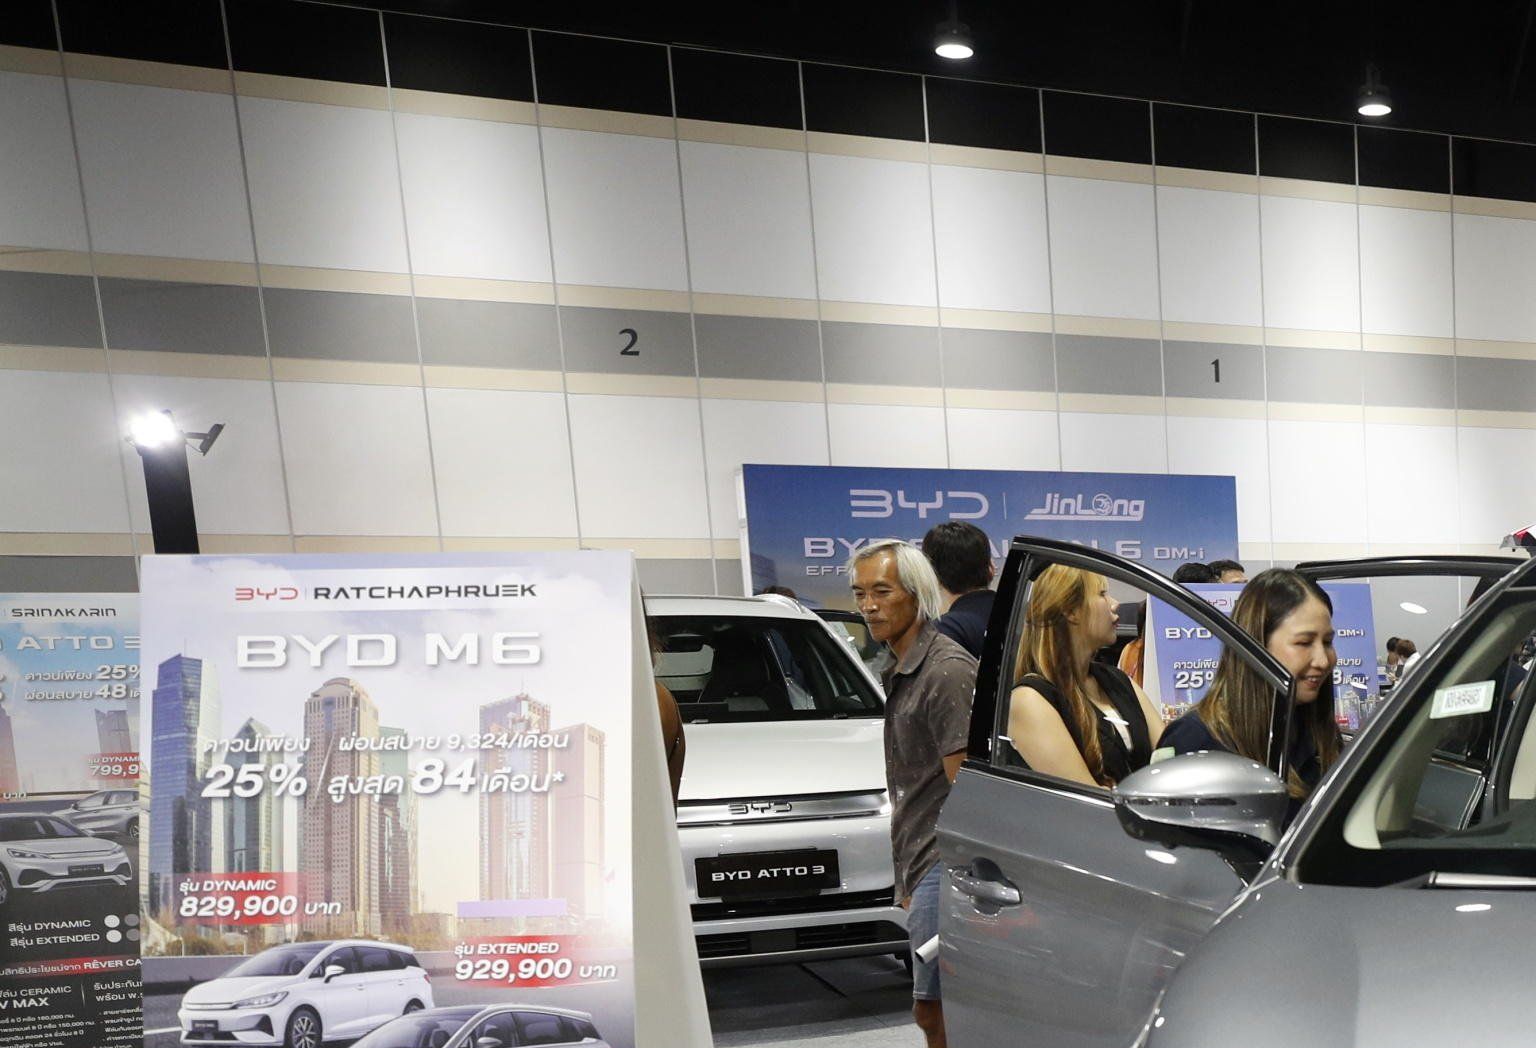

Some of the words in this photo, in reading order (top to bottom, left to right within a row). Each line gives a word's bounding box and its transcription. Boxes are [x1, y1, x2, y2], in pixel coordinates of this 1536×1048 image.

[619, 328, 641, 356] 2
[1209, 359, 1221, 383] 1
[850, 489, 989, 519] BYD
[1024, 492, 1145, 521] JinLong
[804, 537, 893, 557] BY
[1115, 540, 1142, 559] 6
[1154, 547, 1205, 560] DM-i
[235, 587, 298, 601] BYD
[314, 584, 537, 600] RATCHAPHRUEK
[1165, 627, 1212, 639] BYD
[17, 636, 114, 650] ATTO
[237, 633, 396, 667] BYD
[425, 632, 543, 665] M6
[1173, 657, 1219, 669] ดาวน์เพีย
[1335, 658, 1361, 666] สบาย
[95, 684, 127, 699] 48
[203, 732, 311, 753] ดาวน์เพียง
[338, 731, 440, 751] ผ่อนสบาย
[90, 764, 140, 776] 799,9
[200, 763, 308, 797] 25%
[328, 773, 404, 803] สูงสุด
[412, 758, 476, 794] 84
[712, 870, 751, 881] BYD
[757, 866, 808, 878] ATTO
[812, 865, 825, 875] 3
[203, 879, 277, 891] DYNAMIC
[180, 895, 297, 920] 829,900
[304, 901, 342, 915] บาท
[34, 920, 91, 931] DYNAMIC
[36, 934, 100, 945] EXTENDED
[477, 942, 559, 955] EXTENDED
[455, 958, 572, 983] 929,900
[579, 964, 616, 978] บาท
[20, 986, 72, 996] CERAMIC
[13, 997, 49, 1009] MAX
